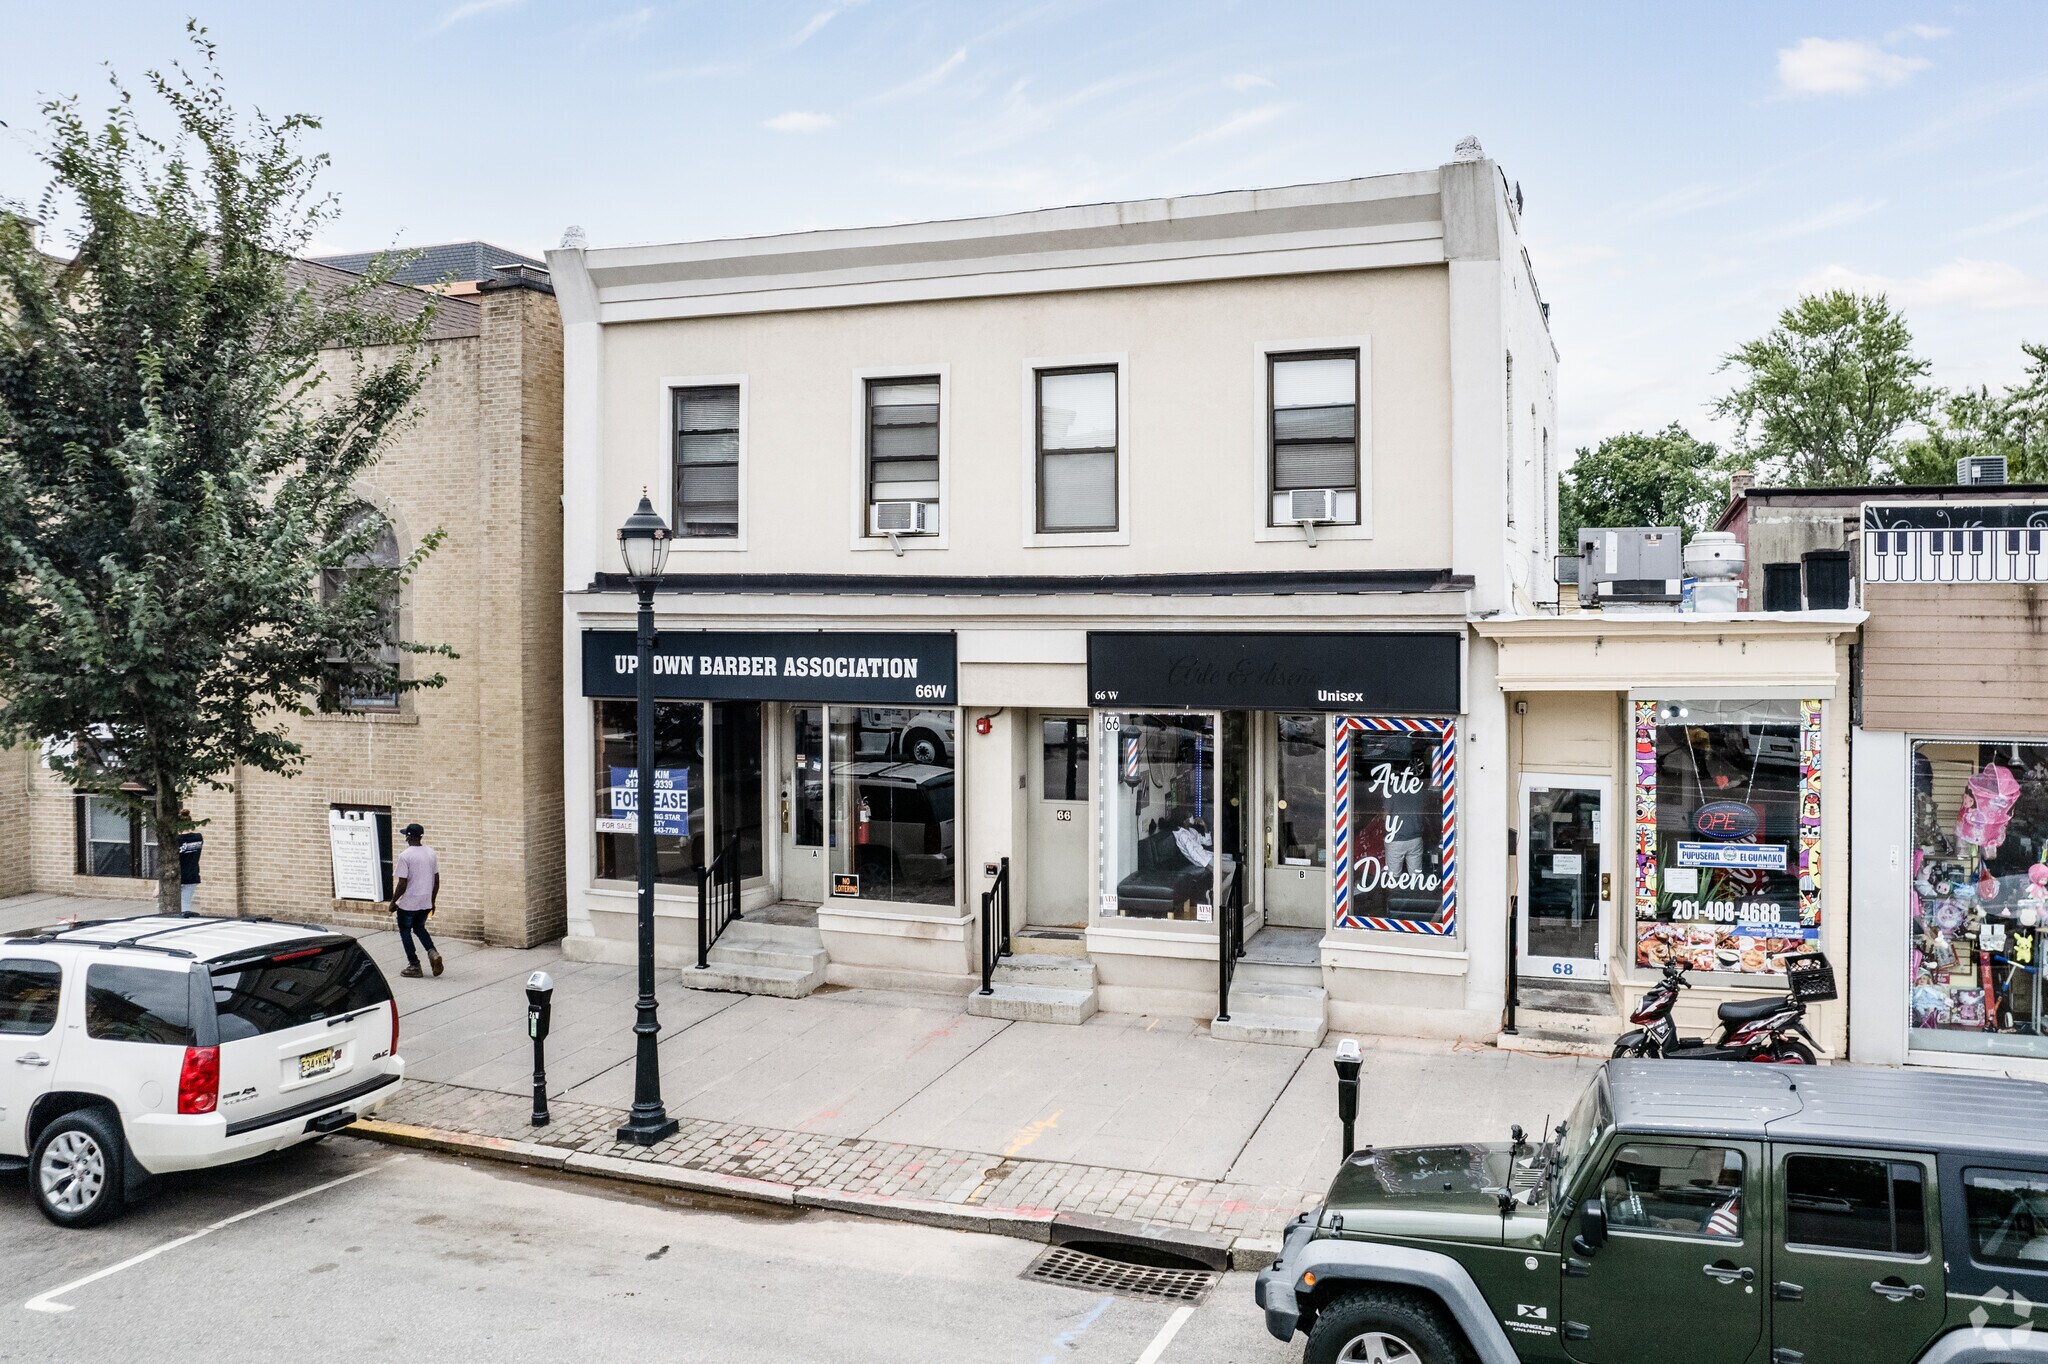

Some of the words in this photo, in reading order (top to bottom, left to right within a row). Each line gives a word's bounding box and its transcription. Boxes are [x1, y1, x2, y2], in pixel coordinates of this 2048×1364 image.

[614, 655, 694, 675] UPOWN
[700, 656, 777, 677] BARBER
[783, 656, 919, 679] ASSOCIATION
[915, 684, 947, 699] 66W
[1095, 690, 1106, 700] 66
[1108, 690, 1119, 700] W
[1317, 689, 1364, 702] Unisex
[1105, 717, 1120, 731] 66
[655, 770, 669, 779] KIM
[1368, 763, 1424, 799] Arte
[654, 792, 687, 809] EASE
[1057, 811, 1071, 821] 66
[1697, 812, 1740, 831] OPE
[1384, 815, 1404, 844] y
[1682, 851, 1720, 861] PUPUSERIA
[1740, 853, 1747, 862] EL
[1748, 853, 1783, 863] GUANAKO
[842, 877, 850, 885] NO
[1299, 870, 1305, 879] B
[1353, 856, 1442, 893] Diseño
[835, 884, 858, 893] LOITERING
[1198, 905, 1211, 913] ATM
[1671, 899, 1781, 923] 201-408-4688
[1552, 962, 1573, 976] 68
[1504, 1320, 1557, 1333] WRANGLER
[1512, 1327, 1551, 1336] UNLIMITED
